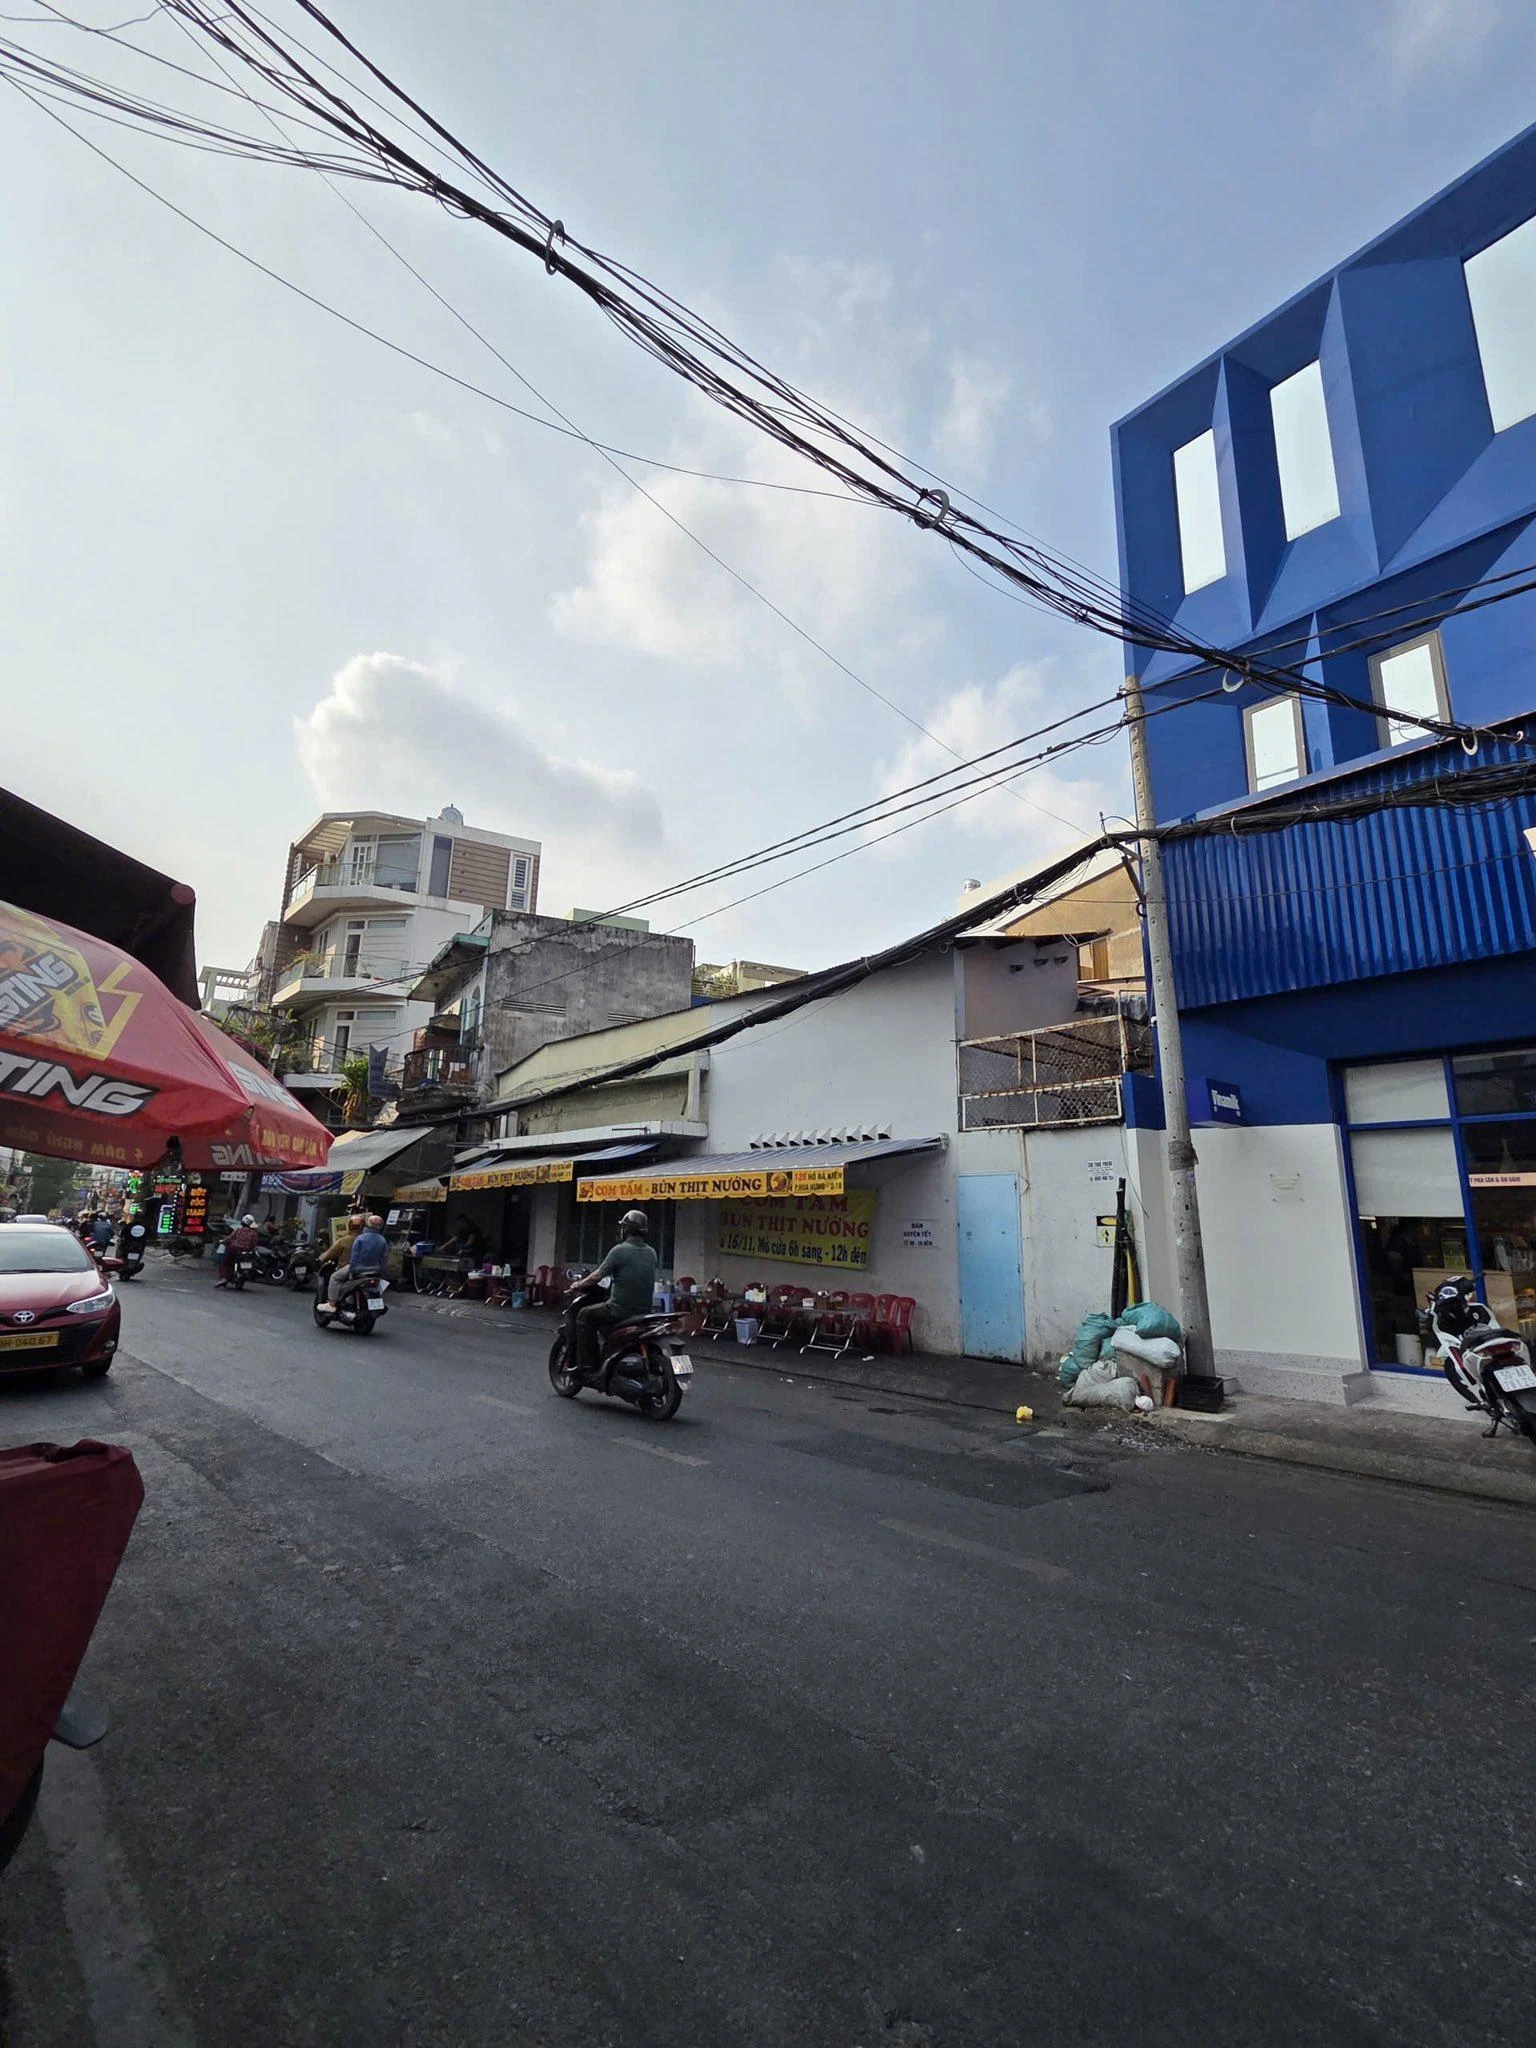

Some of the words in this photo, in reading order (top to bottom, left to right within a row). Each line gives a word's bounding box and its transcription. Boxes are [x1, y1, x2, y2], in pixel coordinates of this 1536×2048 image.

[0, 1052, 154, 1115] TING
[651, 1179, 676, 1194] BÚN
[679, 1180, 709, 1196] THỊT
[712, 1176, 762, 1192] NƯỚNG
[757, 1215, 797, 1236] THỊT
[802, 1215, 869, 1239] NƯỚNG
[801, 1242, 823, 1263] sáng
[831, 1244, 848, 1262] 12h
